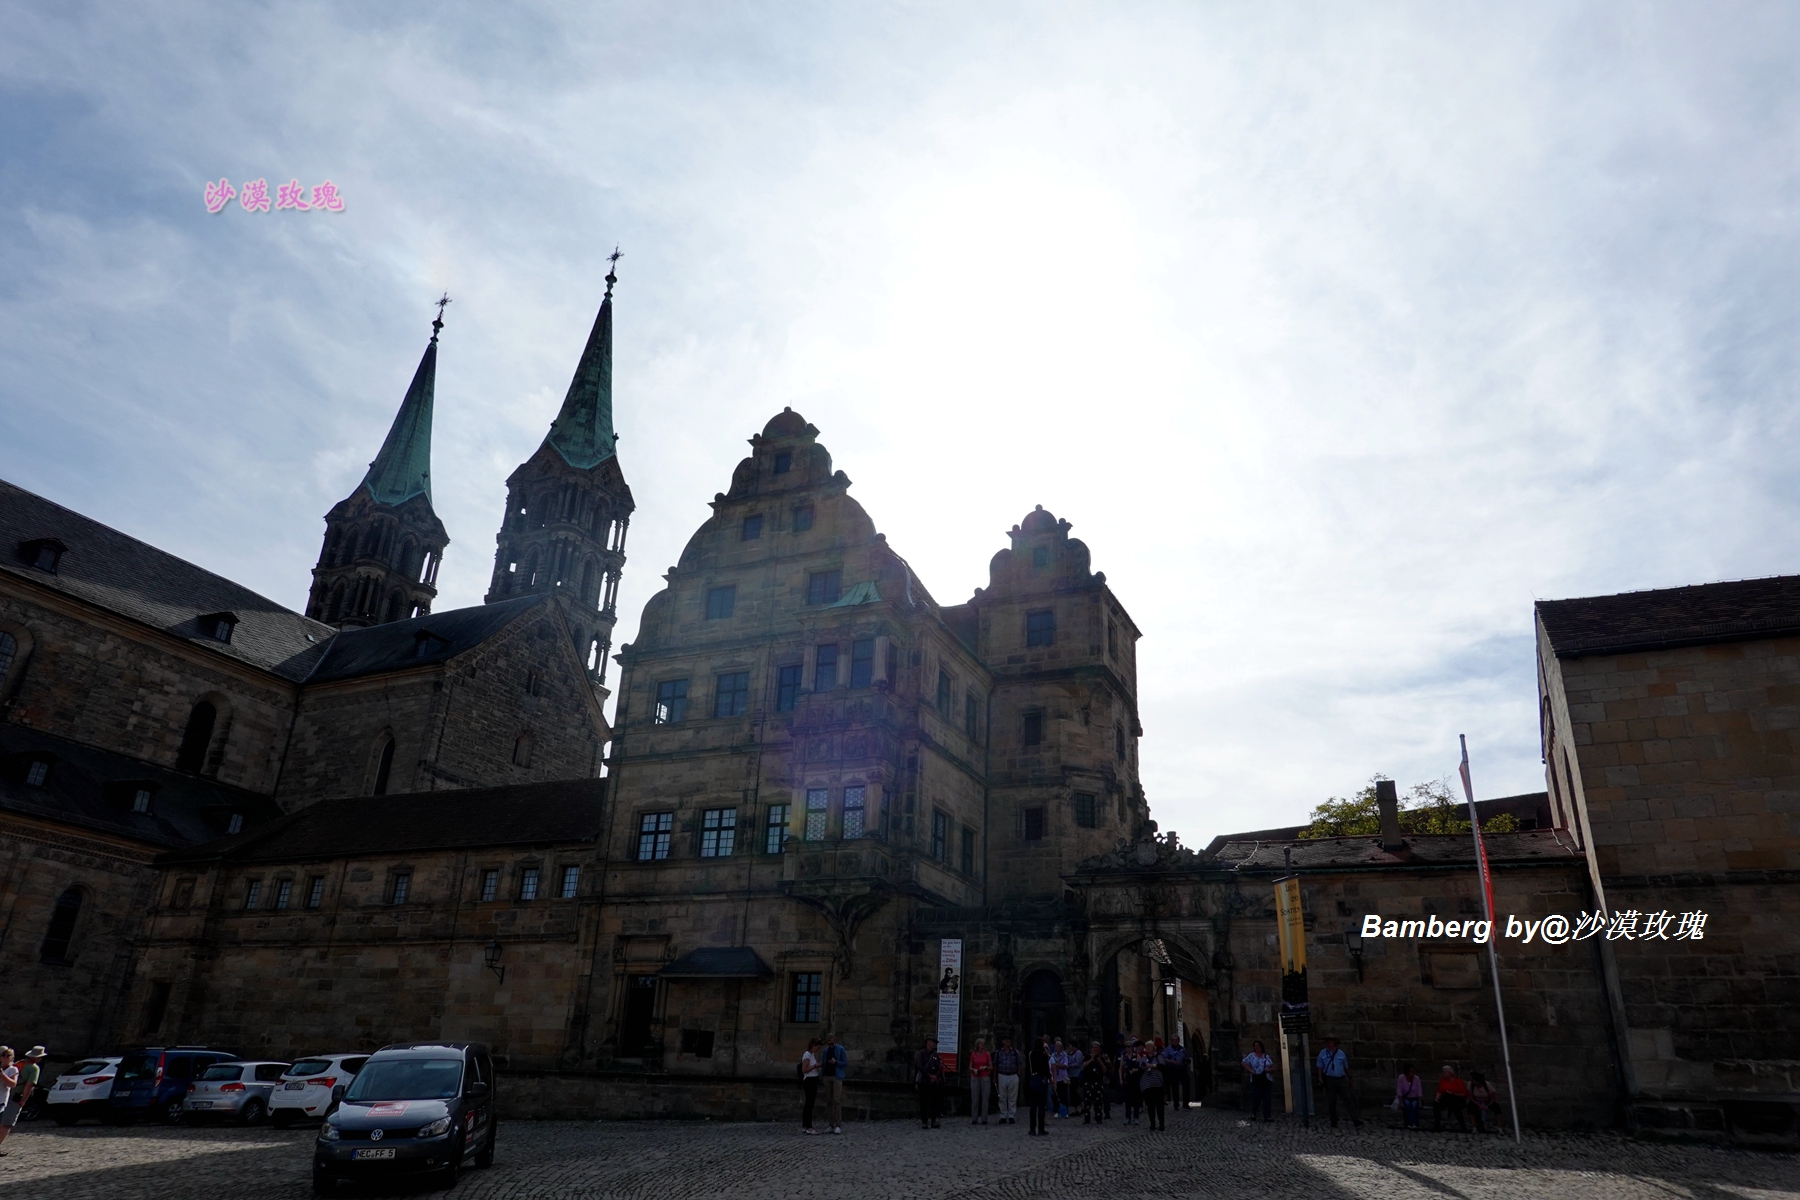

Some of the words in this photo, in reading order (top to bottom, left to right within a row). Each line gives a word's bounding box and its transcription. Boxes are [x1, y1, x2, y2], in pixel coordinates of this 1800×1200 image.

[357, 1149, 371, 1158] NEC
[375, 1149, 386, 1158] FF
[388, 1149, 393, 1158] 5
